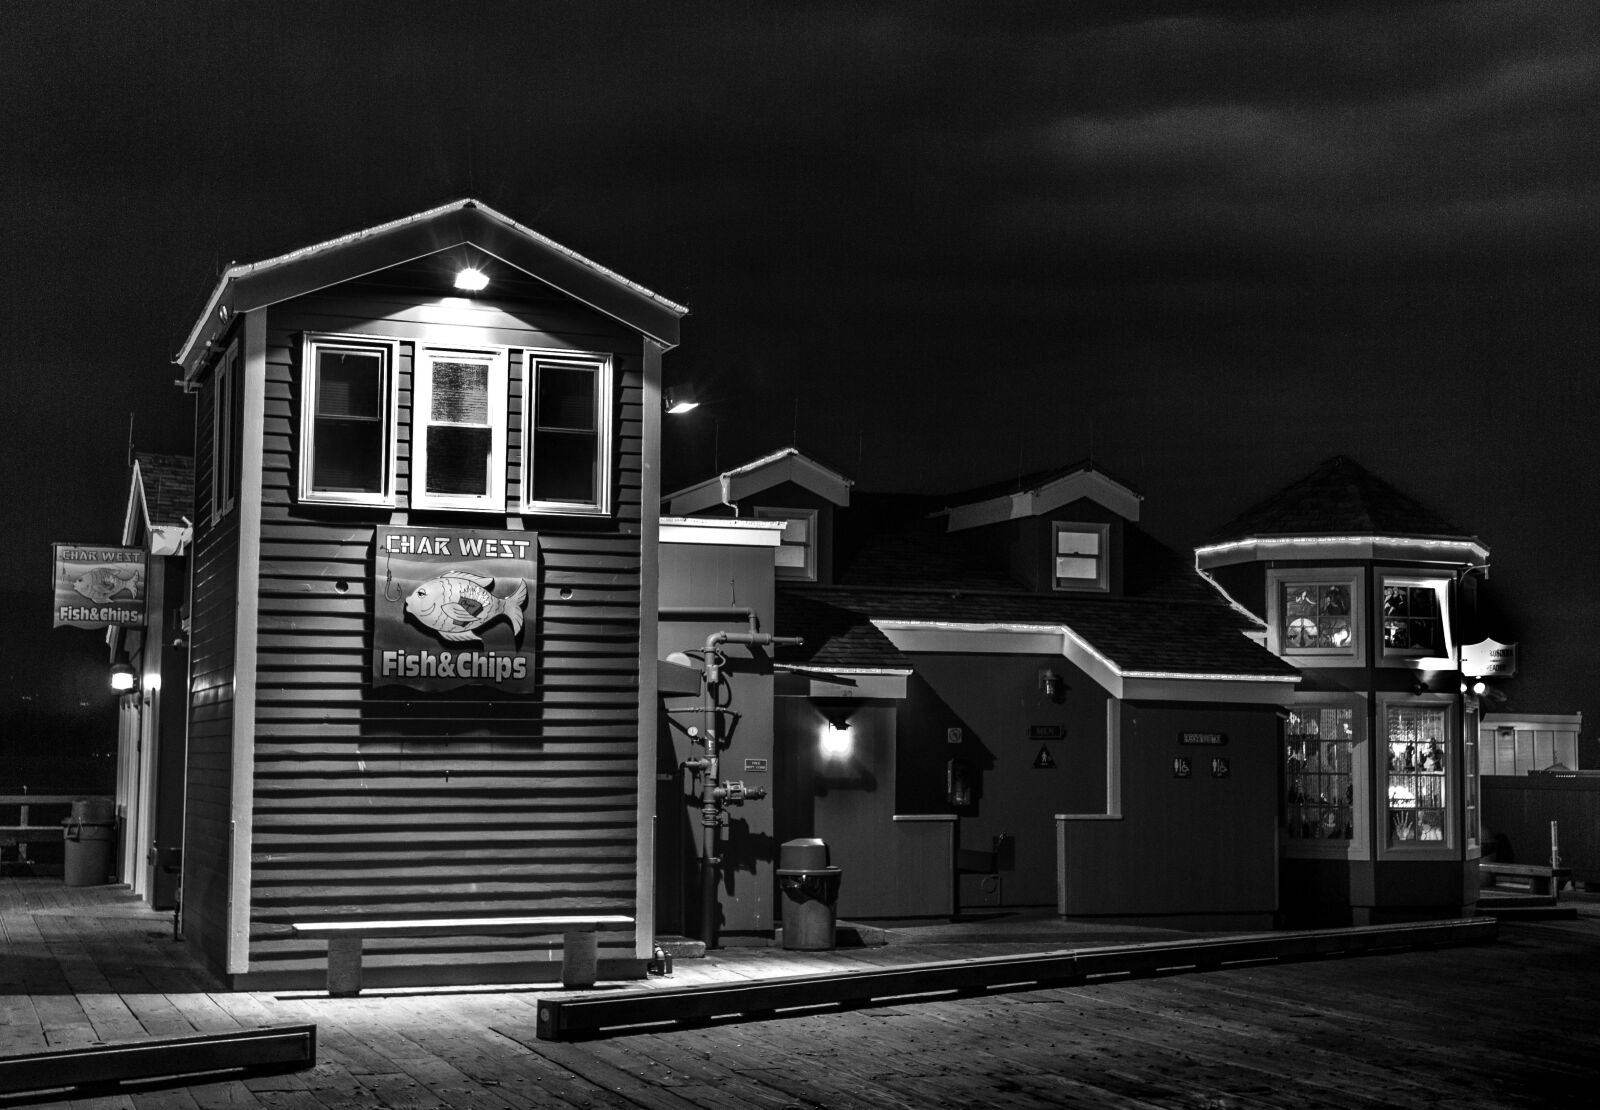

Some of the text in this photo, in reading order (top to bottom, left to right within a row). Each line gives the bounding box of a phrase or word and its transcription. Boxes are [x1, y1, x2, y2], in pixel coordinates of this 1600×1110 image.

[62, 550, 140, 562] CHAR WEST
[386, 535, 530, 558] CHAR WEST
[382, 650, 527, 682] Fish&Chips
